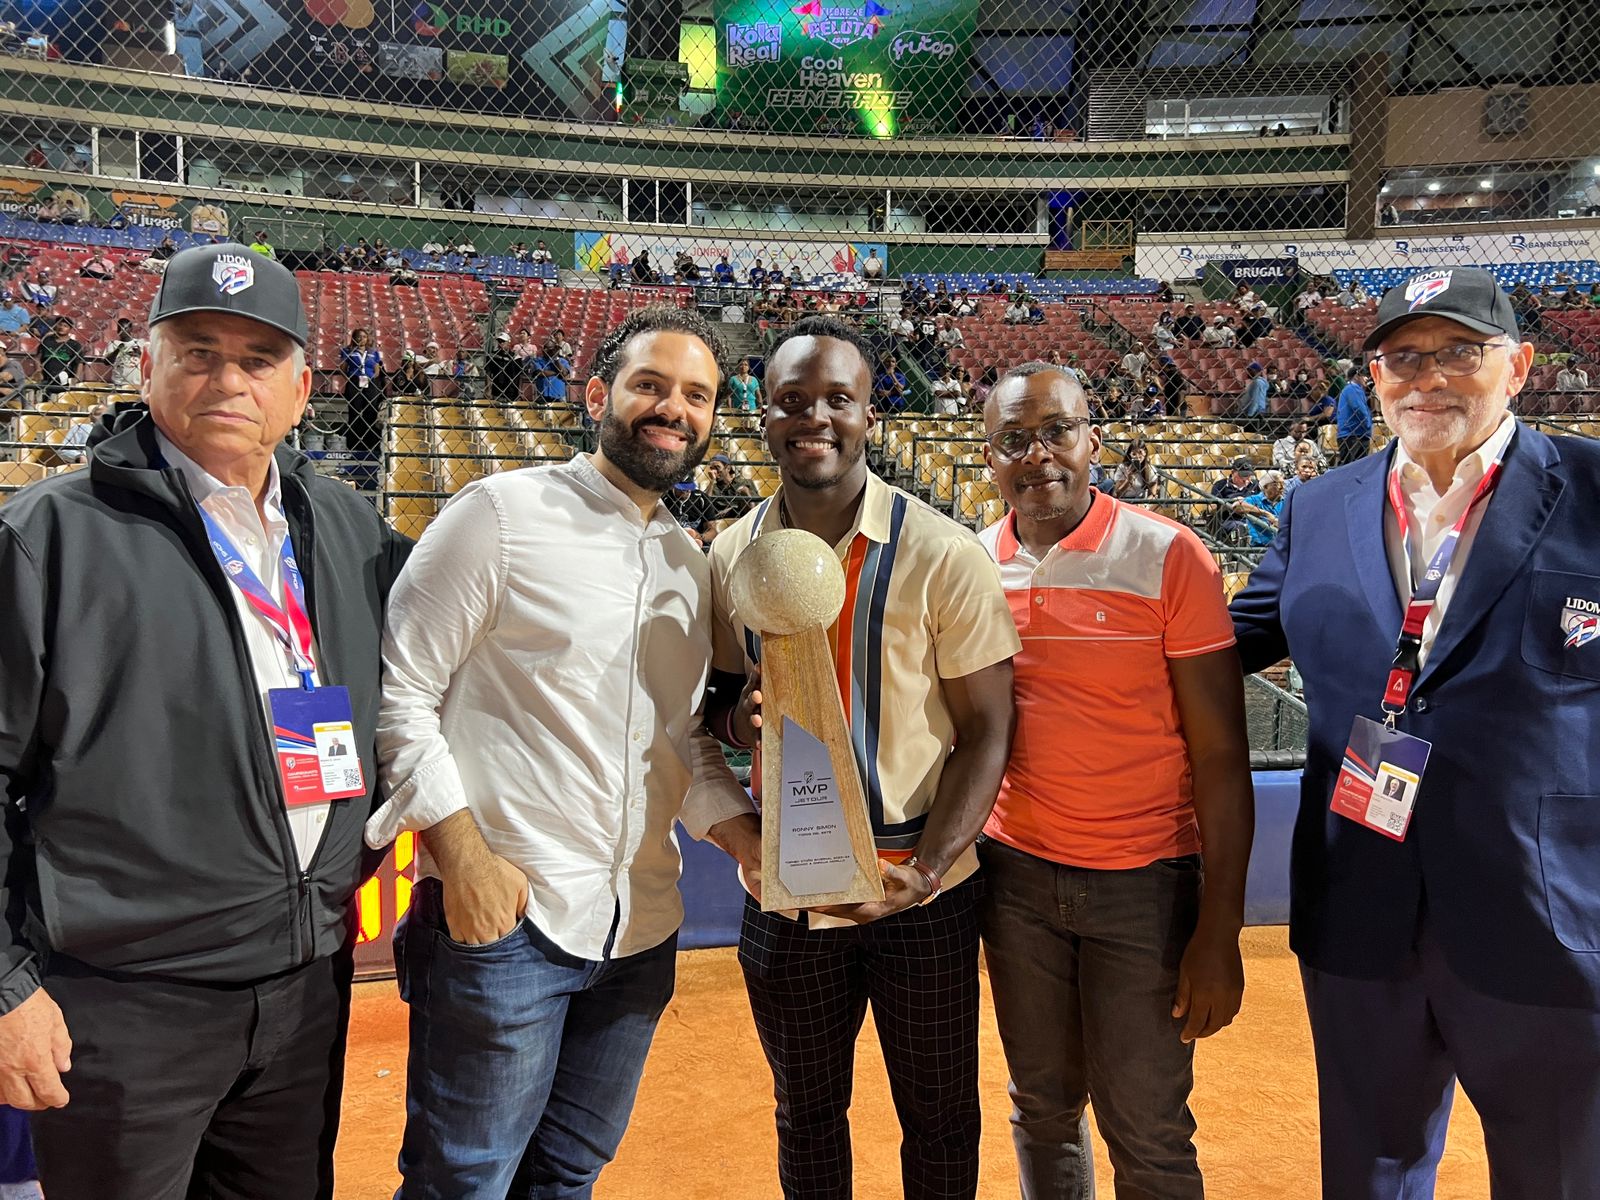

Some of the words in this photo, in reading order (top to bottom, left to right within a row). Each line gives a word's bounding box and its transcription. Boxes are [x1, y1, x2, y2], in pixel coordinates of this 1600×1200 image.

[853, 8, 864, 16] DE
[456, 14, 512, 38] BHD
[808, 20, 874, 40] PELOTA
[729, 22, 779, 46] Kola
[729, 41, 778, 65] Real
[801, 56, 843, 71] Cool
[800, 71, 883, 88] Heaven
[138, 214, 183, 230] juego!
[1411, 245, 1471, 254] BANRESERVAS
[1527, 239, 1590, 249] BANRESERVAS
[1300, 249, 1356, 258] BANRESERVAS
[217, 254, 252, 268] LIDOM
[1234, 267, 1284, 278] BRUGAL
[1409, 270, 1453, 285] LIDOM
[1096, 611, 1106, 622] G
[793, 784, 828, 796] MVP
